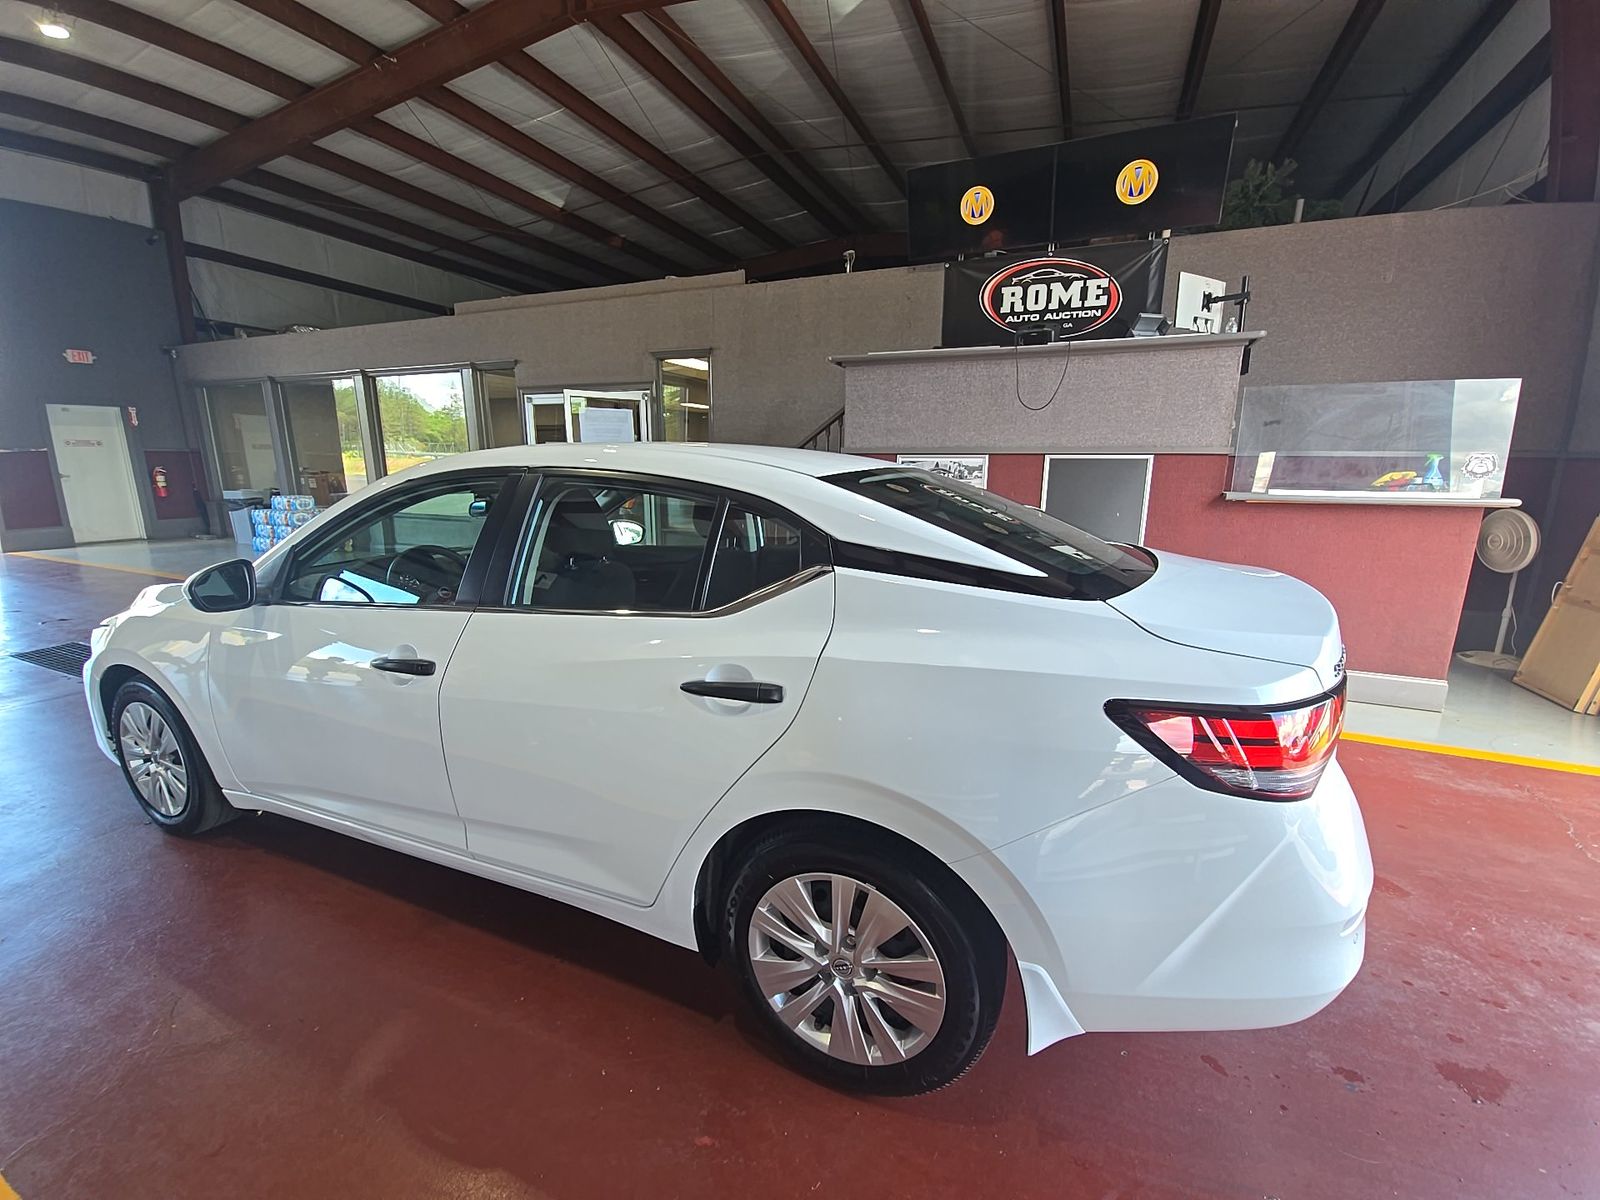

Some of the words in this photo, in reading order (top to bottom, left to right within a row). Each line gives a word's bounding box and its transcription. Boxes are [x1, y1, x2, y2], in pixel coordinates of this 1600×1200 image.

[1000, 278, 1110, 314] ROME
[1005, 314, 1040, 323] AUTO
[1044, 309, 1102, 321] AUCTION
